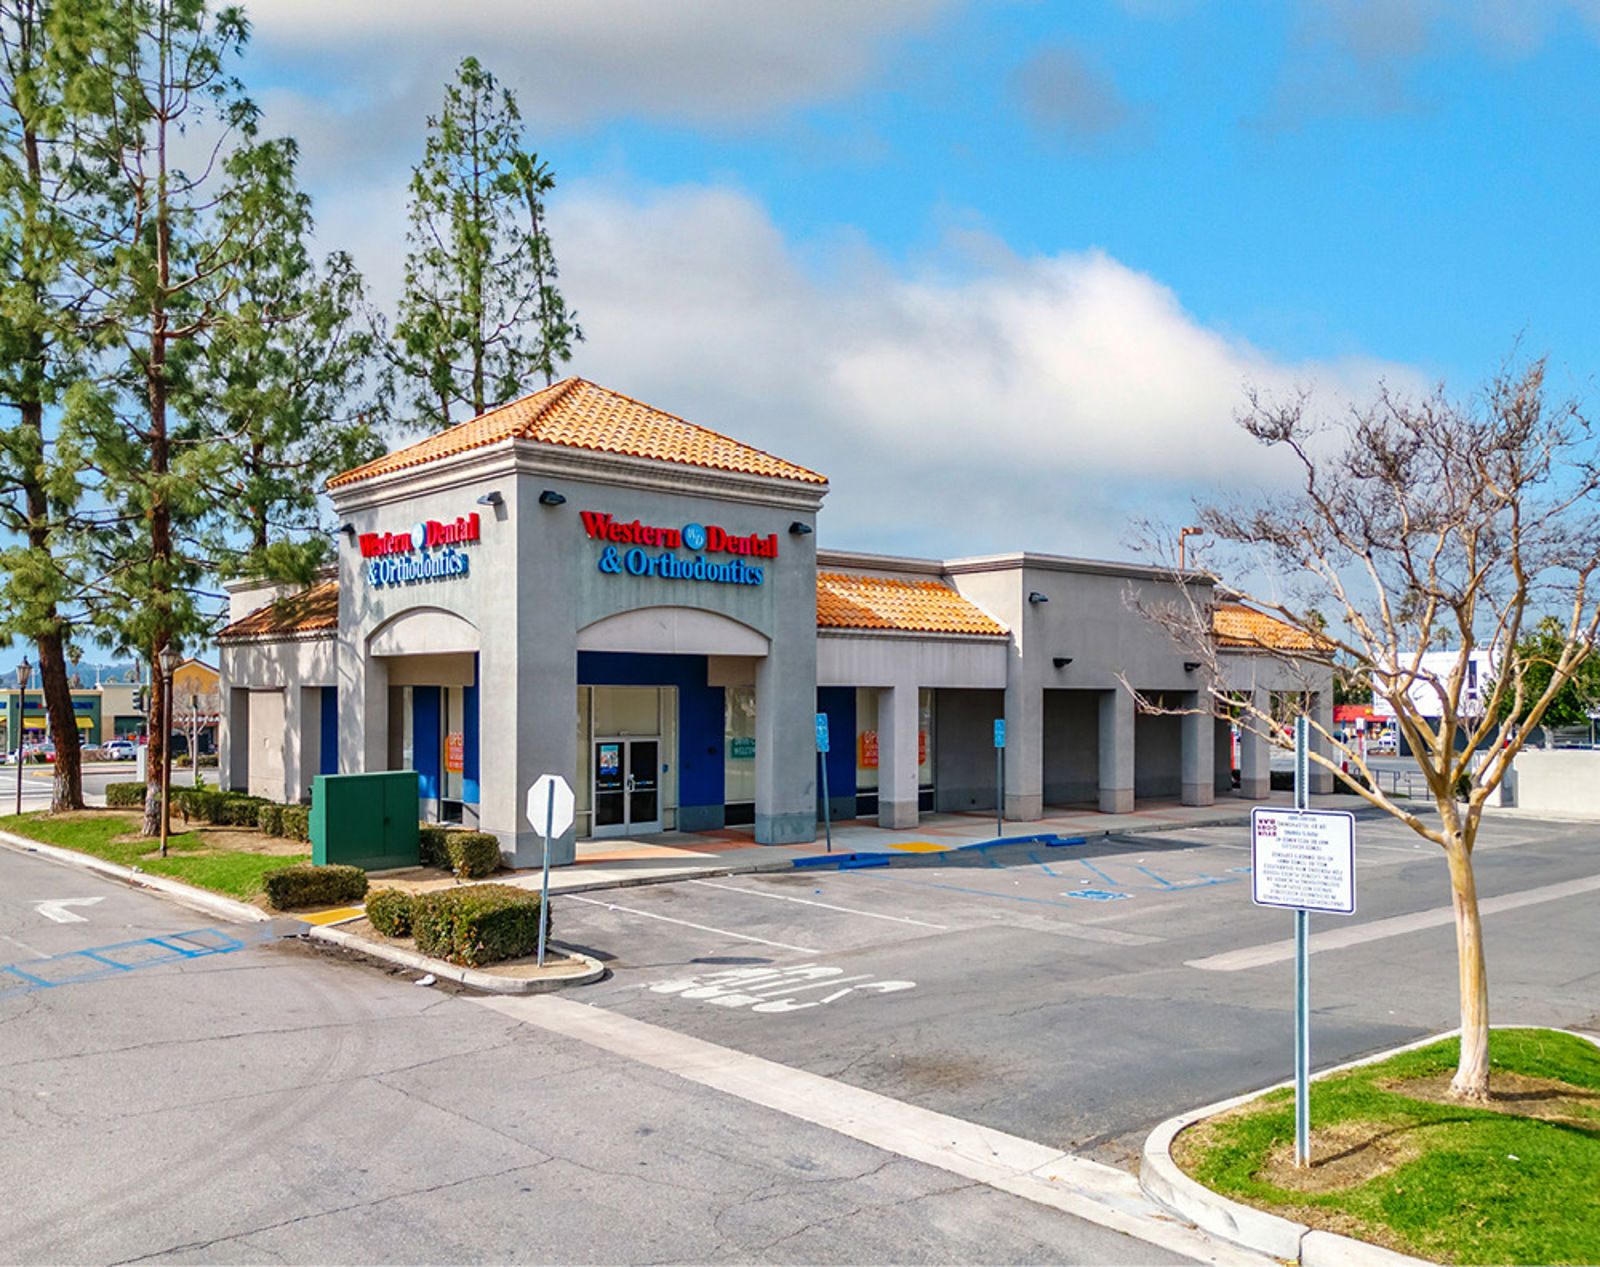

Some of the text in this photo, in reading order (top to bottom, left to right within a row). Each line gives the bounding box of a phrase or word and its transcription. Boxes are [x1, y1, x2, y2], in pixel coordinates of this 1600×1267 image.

[359, 512, 480, 558] Western Dental
[579, 510, 779, 558] Western Dental
[367, 548, 470, 587] & Orthodontics
[598, 545, 764, 586] & Orthodontics
